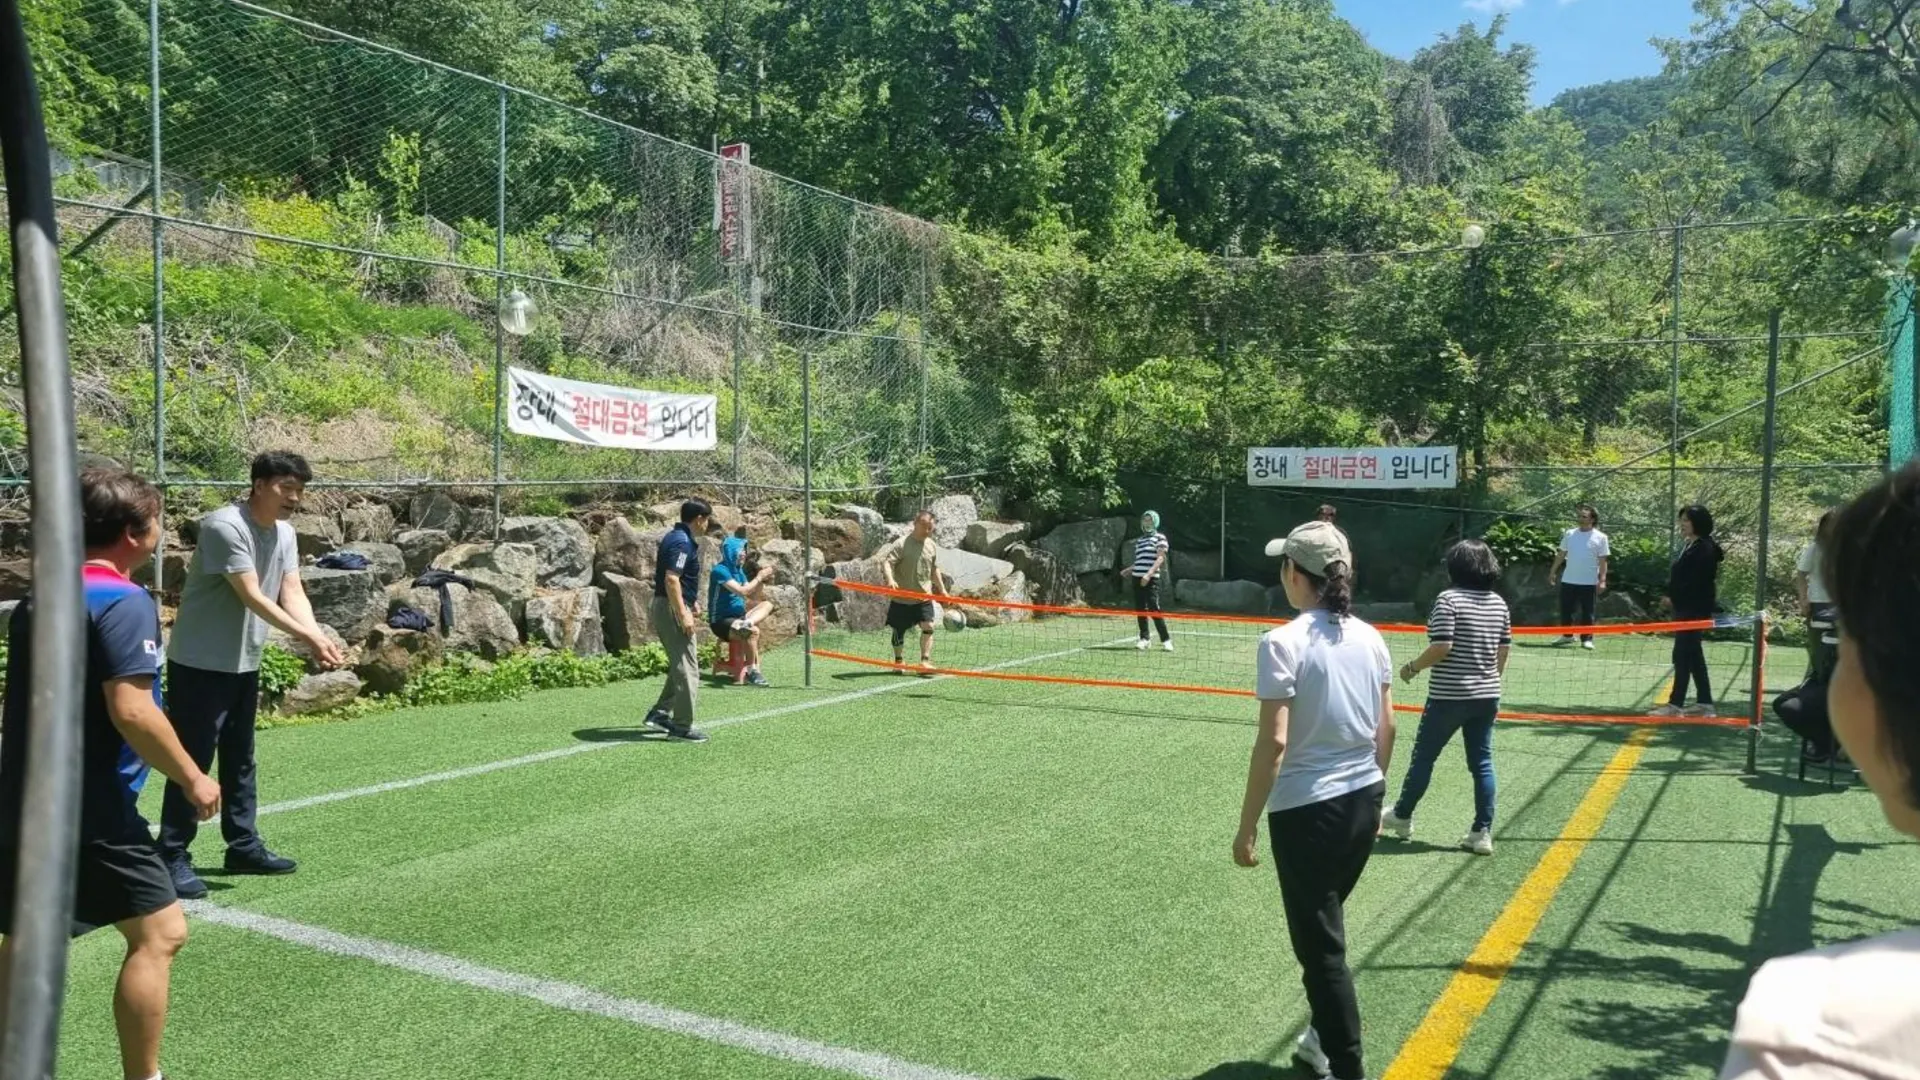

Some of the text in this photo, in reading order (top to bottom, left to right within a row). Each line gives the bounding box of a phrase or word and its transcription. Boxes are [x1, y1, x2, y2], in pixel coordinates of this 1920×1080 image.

[516, 383, 556, 425] 장내
[661, 405, 710, 439] 입니다
[1253, 455, 1287, 479] 장내
[1391, 454, 1450, 480] 입니다
